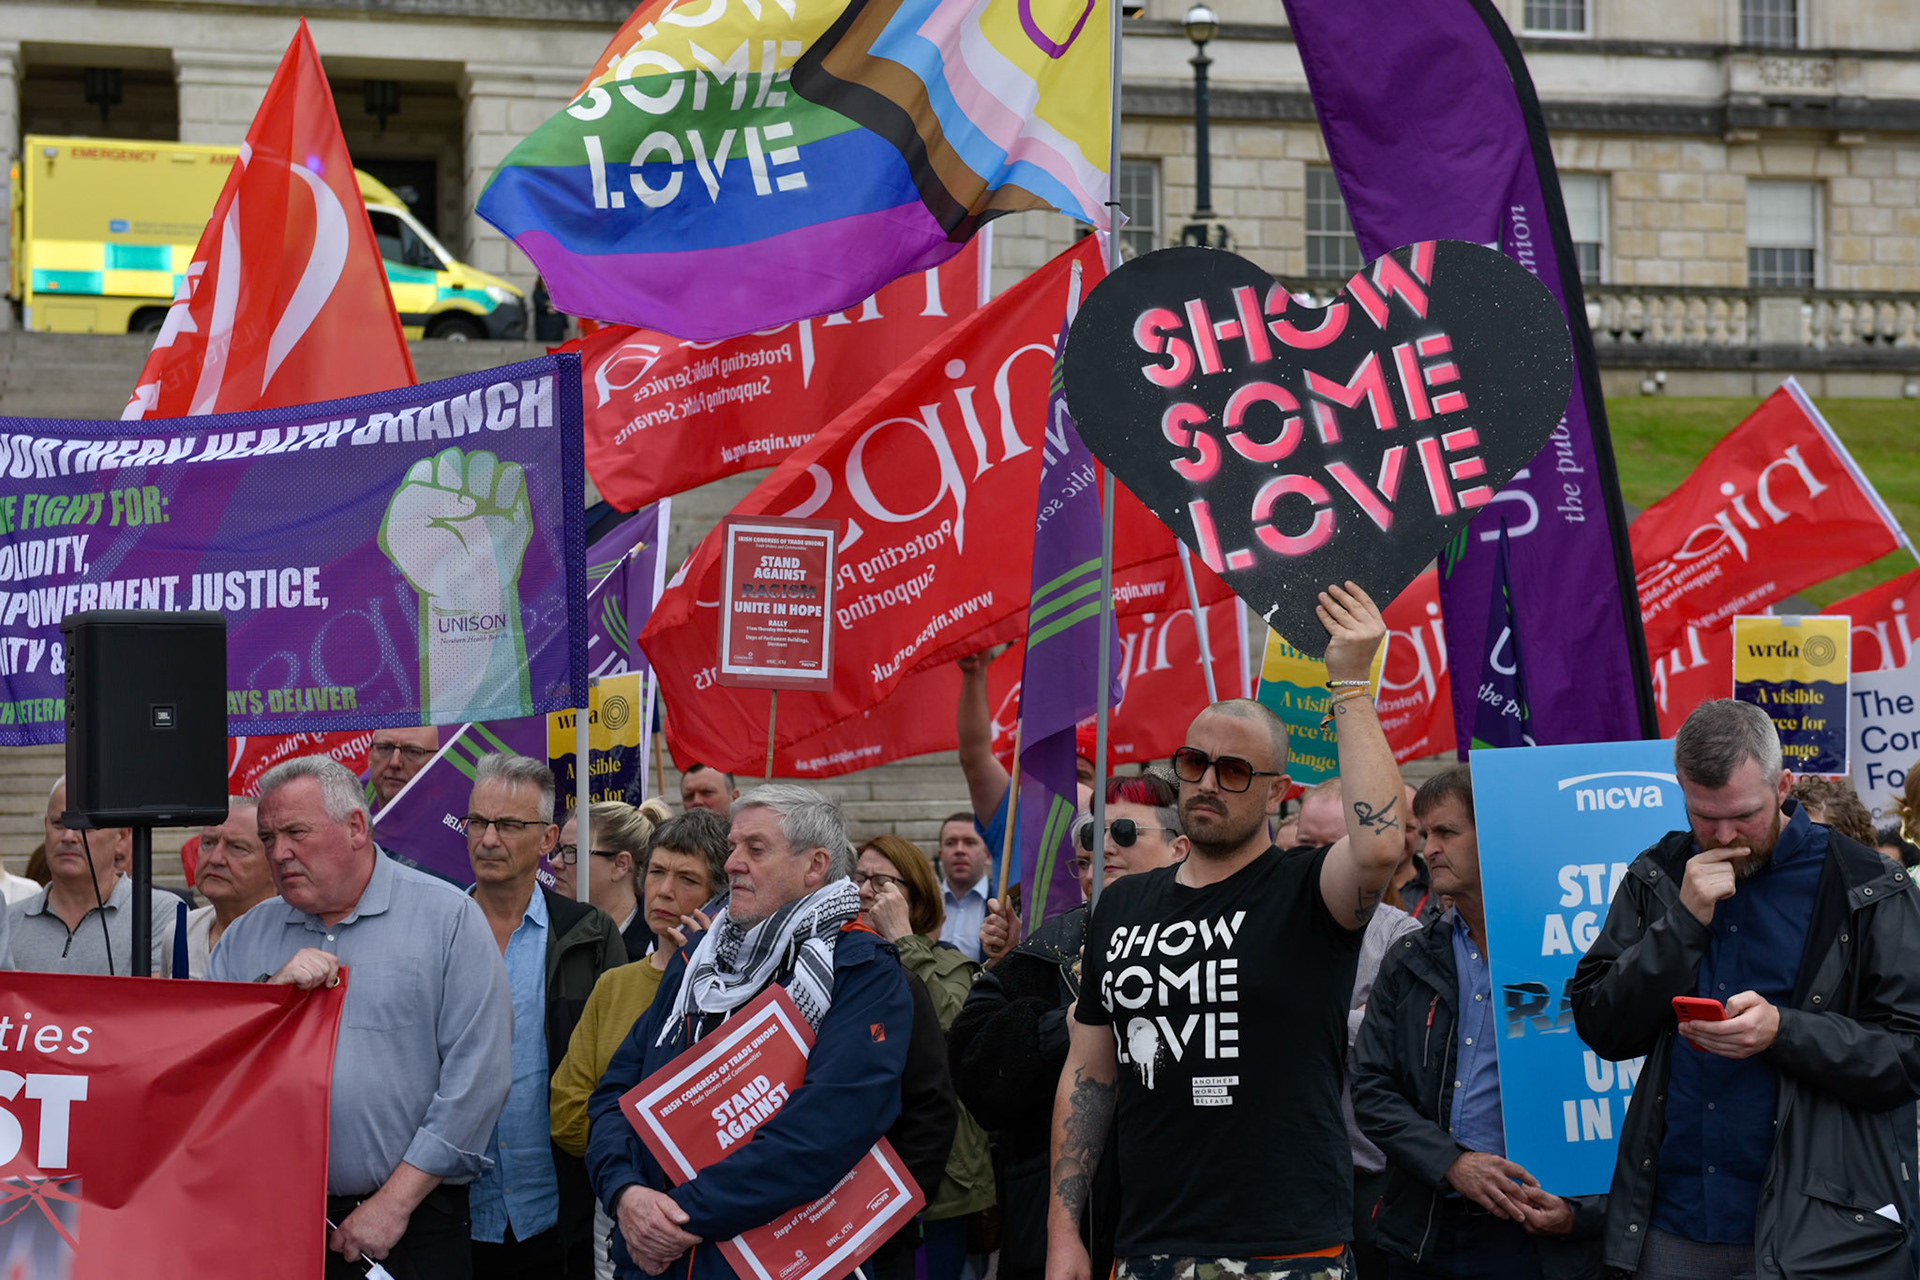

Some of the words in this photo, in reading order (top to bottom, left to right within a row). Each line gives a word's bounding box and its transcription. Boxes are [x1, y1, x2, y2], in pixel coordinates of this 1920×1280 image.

[566, 39, 803, 121] SOME
[71, 147, 156, 162] EMERGENCY
[583, 121, 808, 209] LOVE
[1133, 241, 1436, 388] SHOW
[1161, 333, 1469, 483] SOME
[20, 492, 106, 530] FIGHT
[109, 485, 170, 527] FOR:
[1188, 427, 1495, 574] LOVE
[753, 567, 807, 581] AGAINST
[760, 555, 801, 568] STAND
[189, 567, 330, 613] JUSTICE,
[741, 583, 817, 599] RACISM
[734, 601, 771, 614] UNITE
[773, 603, 787, 615] IN
[789, 604, 822, 617] HOPE
[438, 613, 506, 633] UNISON
[50, 641, 66, 676] &
[1748, 640, 1799, 659] wrda
[227, 689, 264, 715] AYS
[267, 686, 358, 713] DELIVER
[1280, 690, 1292, 708] A
[1756, 688, 1768, 704] A
[1771, 689, 1825, 705] visible
[1852, 690, 1914, 718] The
[157, 711, 171, 720] JBL
[1773, 717, 1798, 731] rce
[1802, 716, 1827, 731] for
[1286, 723, 1318, 739] orce
[1287, 747, 1336, 773] hange
[1781, 745, 1820, 762] ange
[566, 763, 575, 780] A
[589, 757, 622, 776] sible
[1866, 762, 1912, 790] Fo
[1575, 784, 1664, 812] nicva
[1106, 910, 1247, 963] SHOW
[1101, 958, 1239, 1014] SOME
[1113, 1012, 1239, 1064] LOVE
[660, 1098, 682, 1118] IRISH
[681, 1067, 720, 1104] CONGRESS
[718, 1061, 731, 1074] OF
[728, 1045, 754, 1069] TRADE
[751, 1023, 779, 1051] UNIONS
[1193, 1077, 1234, 1085] ANOTHER
[711, 1074, 771, 1127] STAND
[715, 1081, 791, 1150] AGAINST
[1562, 1098, 1613, 1143] IN
[808, 1197, 837, 1224] Stormont
[869, 1192, 890, 1212] nicva
[773, 1221, 792, 1240] Steps
[790, 1214, 799, 1227] of
[826, 1221, 854, 1248] @NIC_ICTU
